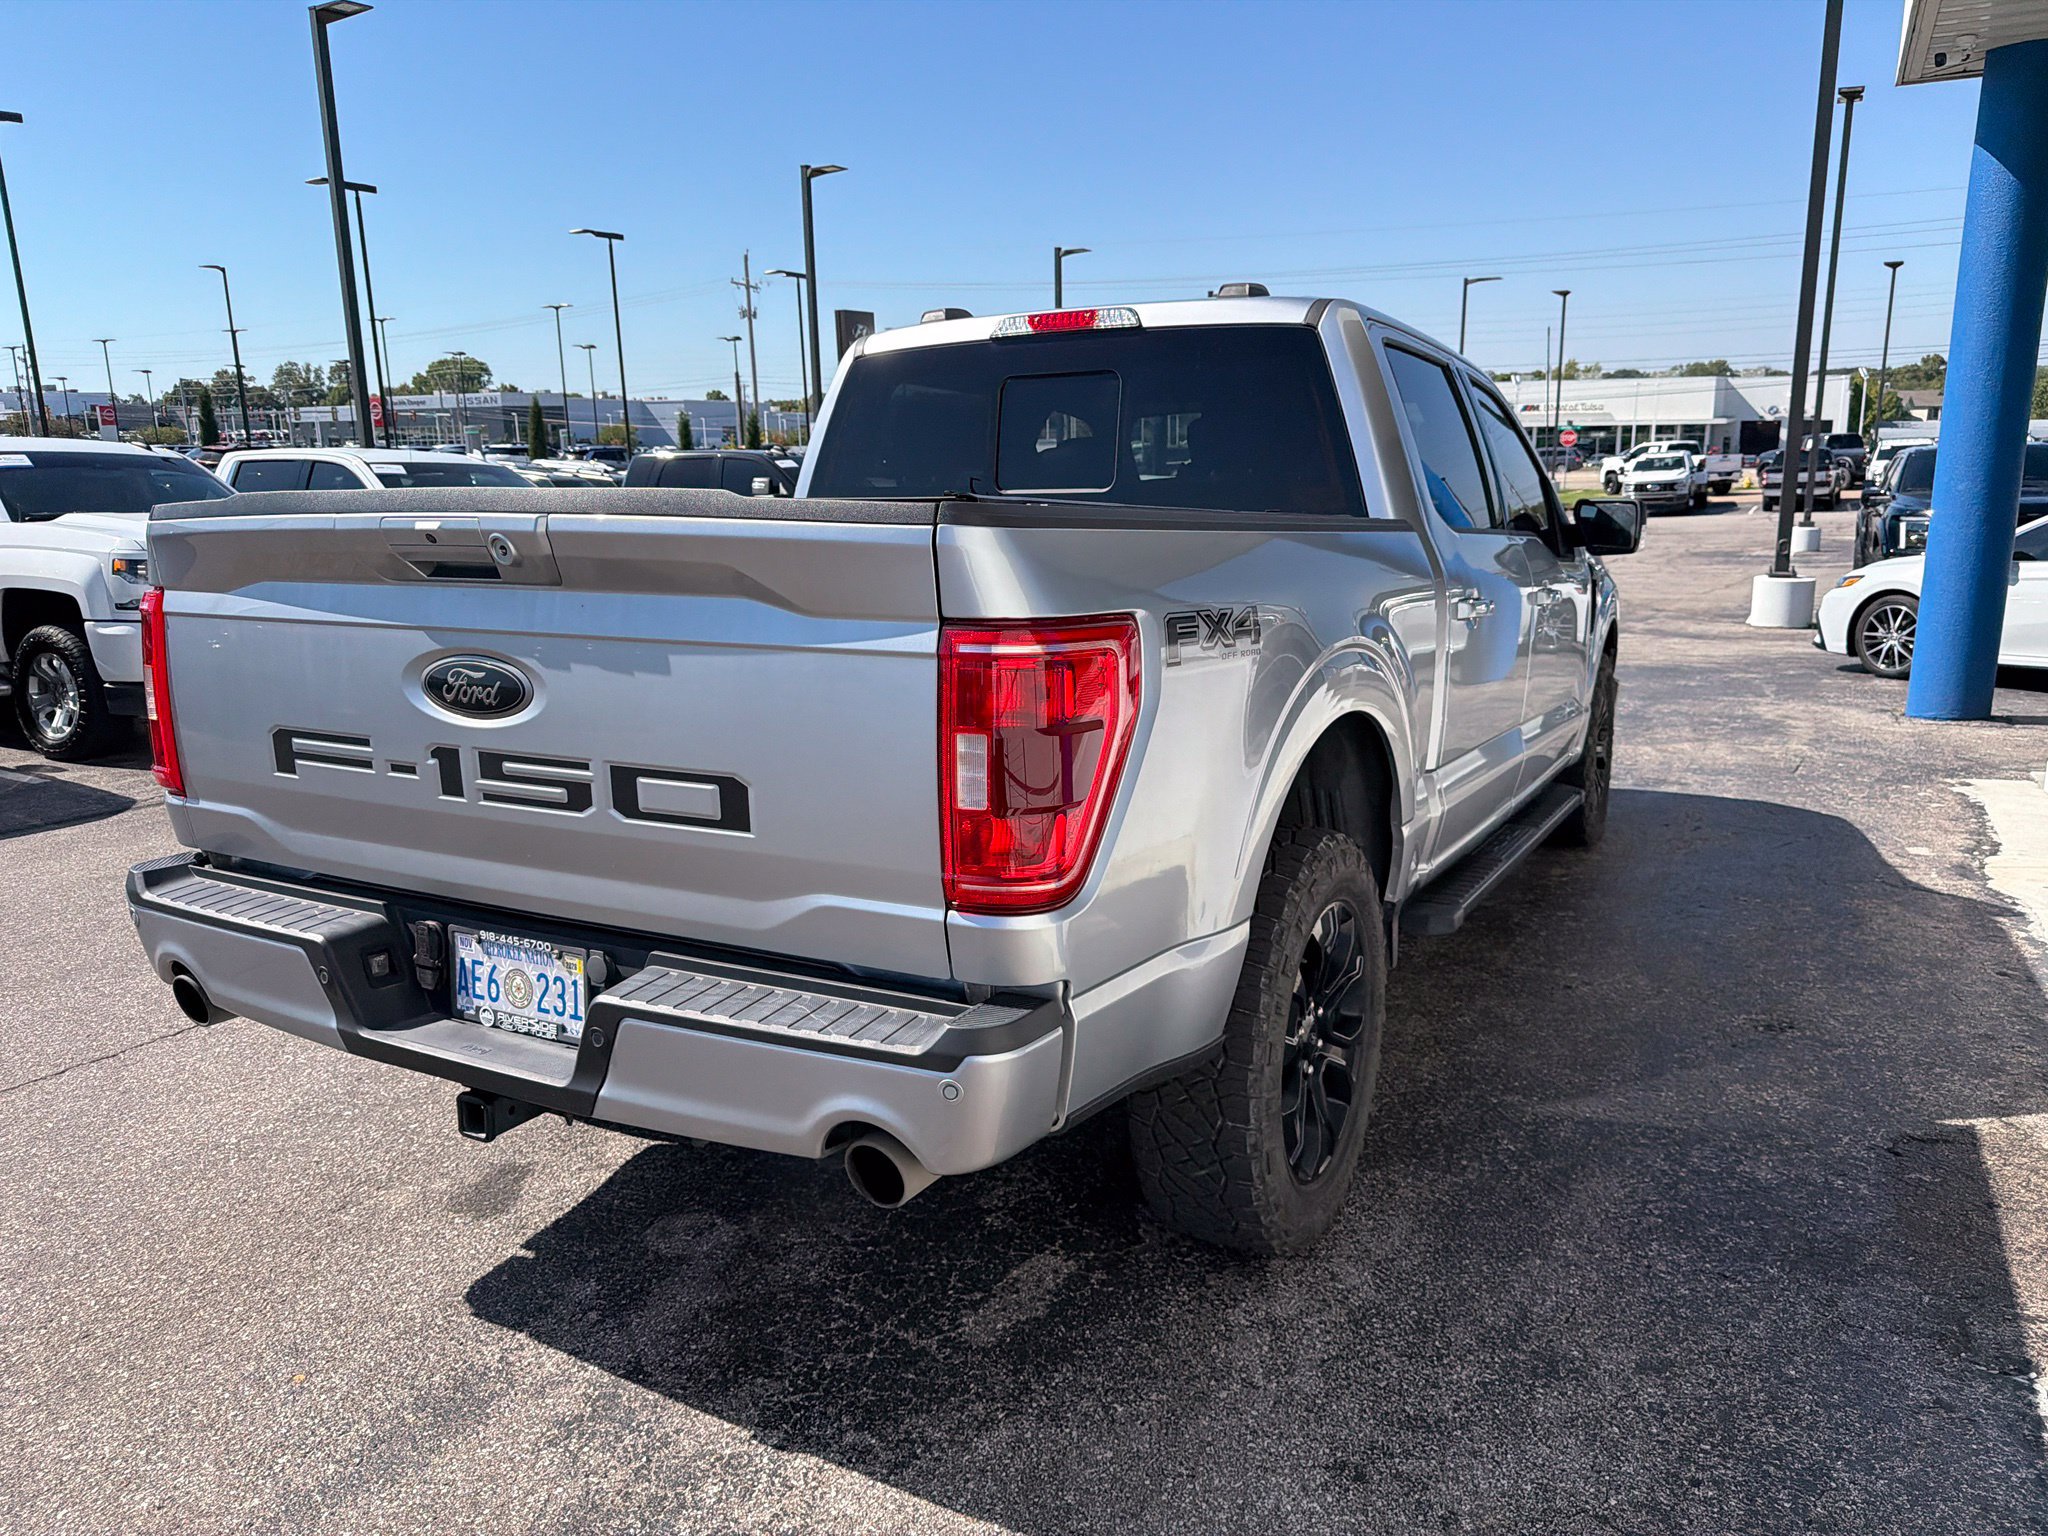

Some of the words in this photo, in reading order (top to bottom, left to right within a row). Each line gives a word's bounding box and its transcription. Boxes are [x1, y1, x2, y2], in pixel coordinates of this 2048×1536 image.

[457, 395, 498, 405] NSSAN
[1561, 433, 1576, 441] STOP
[1164, 605, 1261, 667] FX4
[1222, 650, 1238, 660] OFF
[1240, 648, 1261, 657] ROAD
[442, 667, 500, 706] Ford
[270, 725, 754, 836] F-150
[460, 936, 473, 948] NOV
[480, 930, 552, 952] 918-445-6700
[481, 939, 523, 962] CHEROKEE
[525, 947, 555, 968] NATION
[457, 957, 501, 1003] AE6
[536, 972, 583, 1022] 231
[497, 1012, 557, 1033] RIVERSIDE
